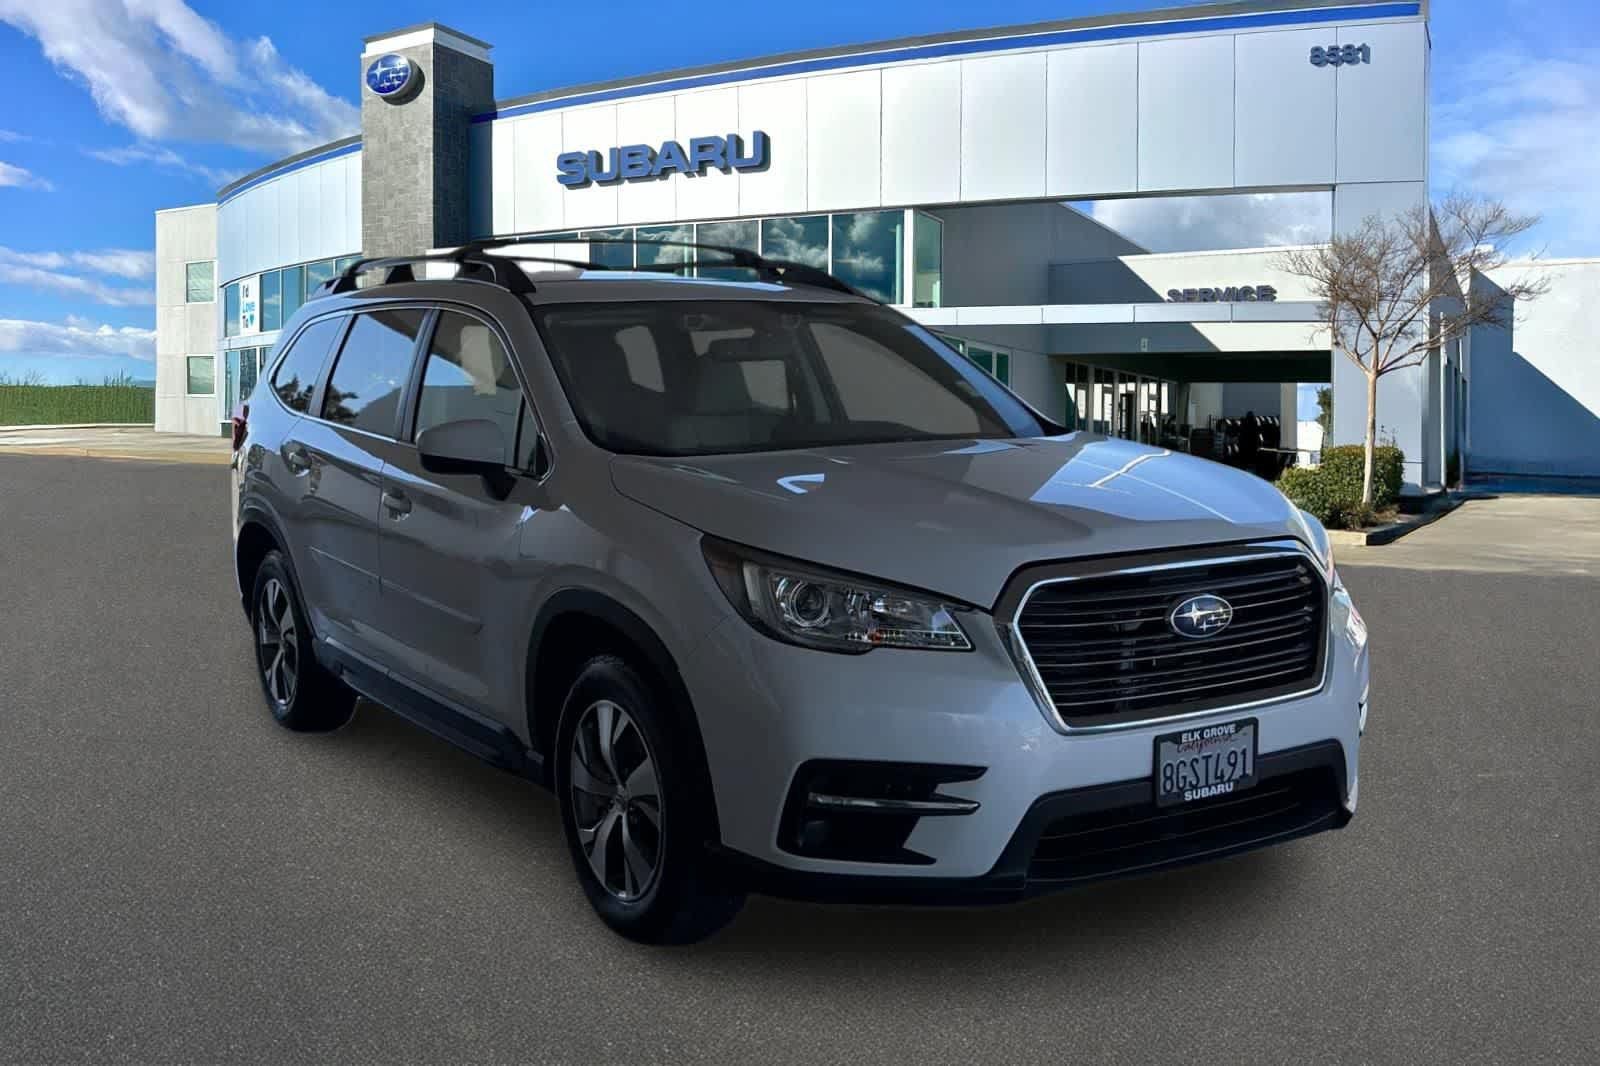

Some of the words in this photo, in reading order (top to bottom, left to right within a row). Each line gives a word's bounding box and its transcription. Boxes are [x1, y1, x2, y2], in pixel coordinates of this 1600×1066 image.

[556, 130, 769, 189] SUBARU
[1167, 285, 1277, 302] SERVICE
[1181, 728, 1201, 742] ELK
[1203, 723, 1236, 739] GROVE
[1162, 745, 1248, 793] 8GST491
[1184, 782, 1234, 800] SUBARU
